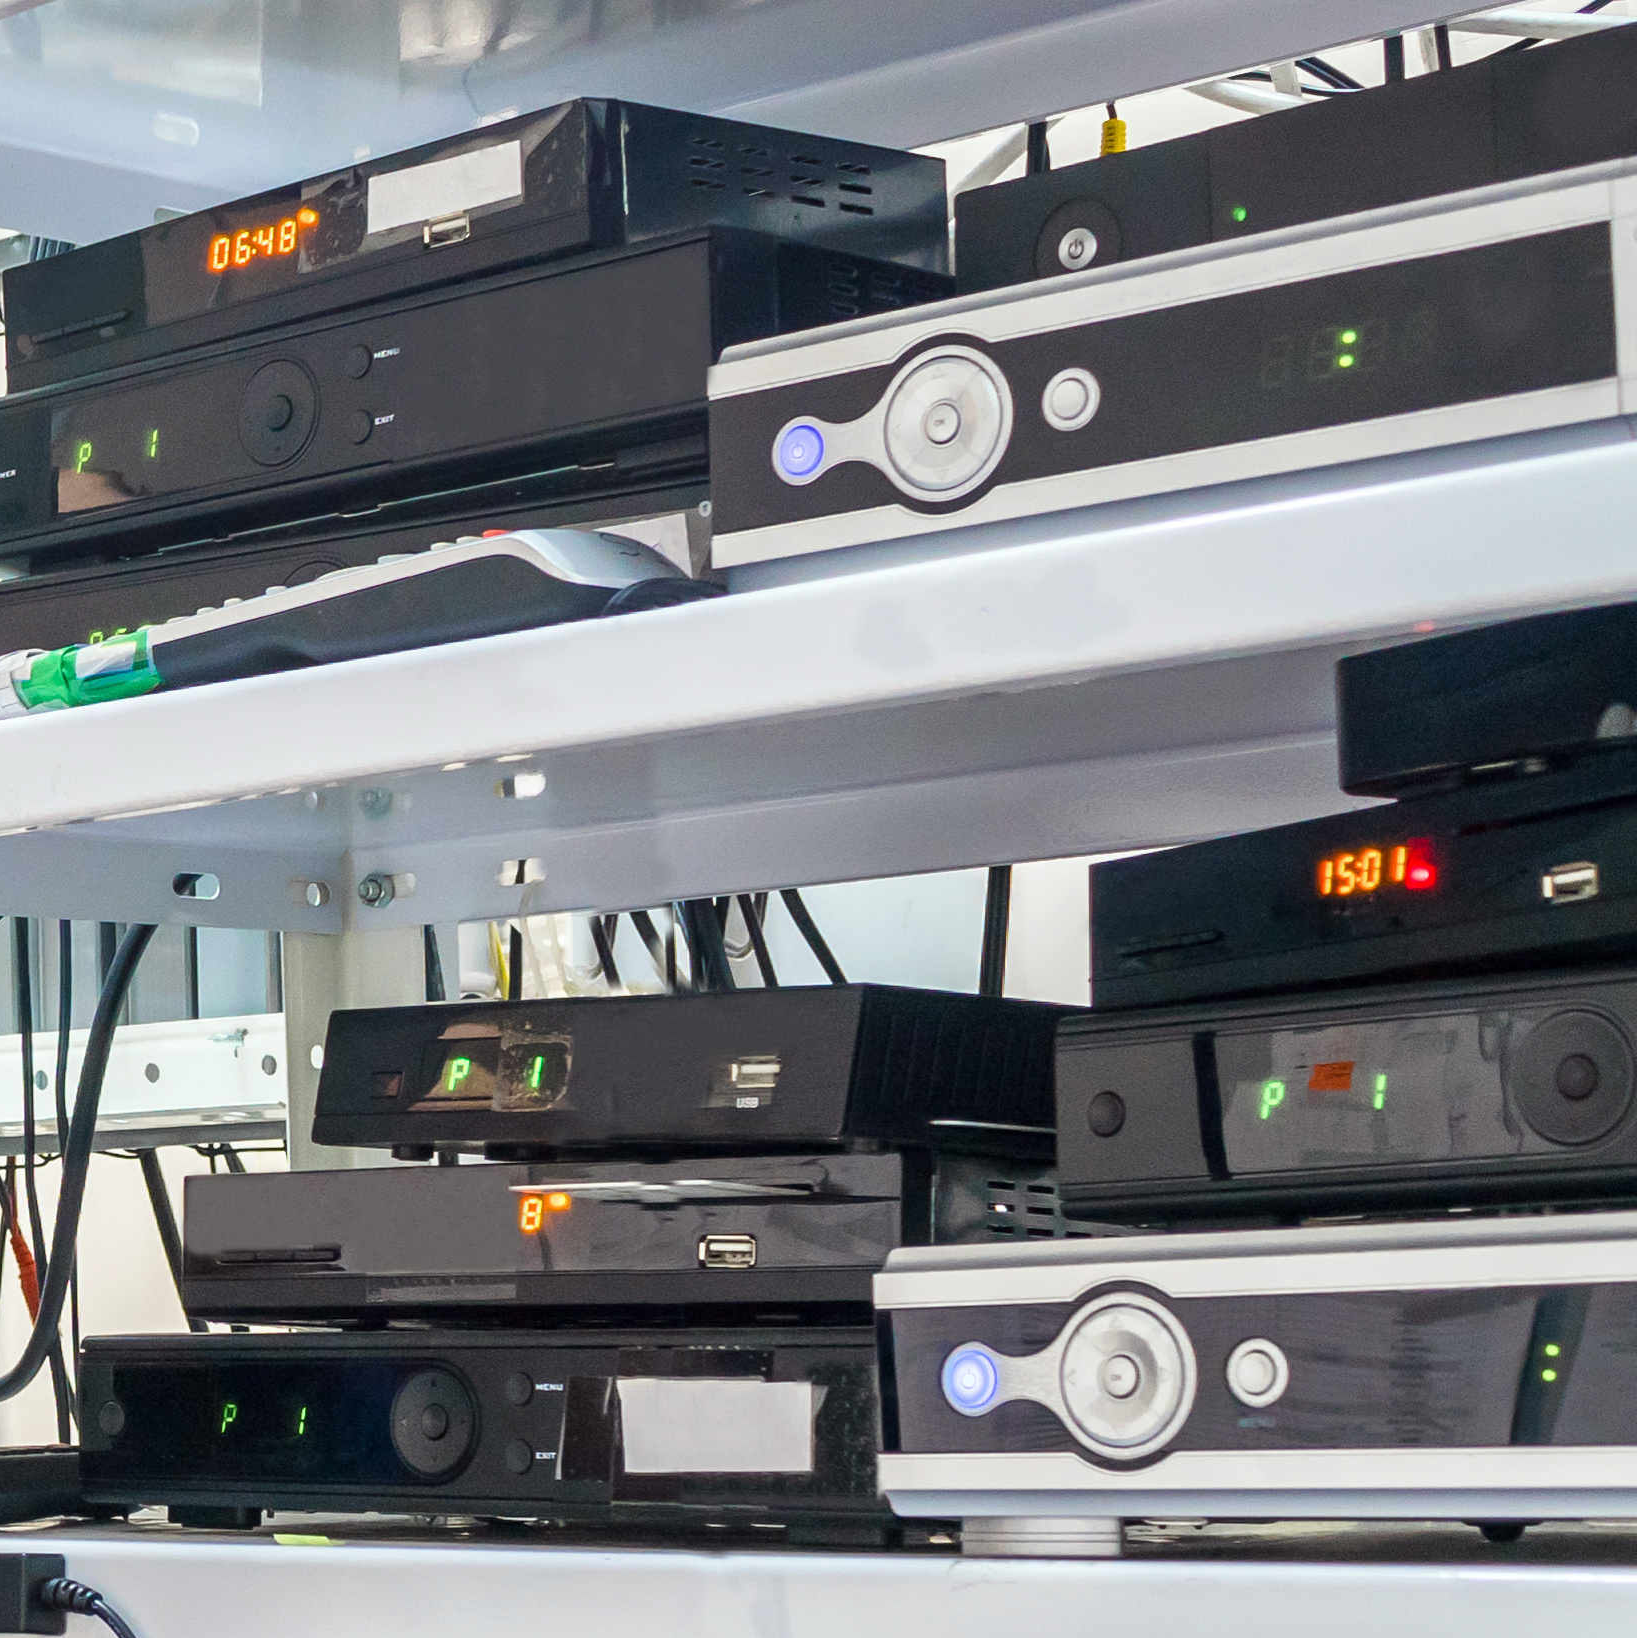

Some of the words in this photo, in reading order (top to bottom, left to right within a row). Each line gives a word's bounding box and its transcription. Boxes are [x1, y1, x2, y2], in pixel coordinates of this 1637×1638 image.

[212, 219, 297, 270] 06:48
[373, 348, 400, 359] MENU
[77, 442, 92, 474] P
[150, 429, 158, 458] 1
[1320, 846, 1406, 895] 15:01
[447, 1057, 471, 1091] P
[529, 1055, 543, 1088] 1
[736, 1097, 759, 1108] USB
[1259, 1081, 1285, 1120] P
[1374, 1073, 1387, 1110] 1
[520, 1198, 543, 1232] 8
[535, 1383, 564, 1392] MENU
[221, 1404, 237, 1434] P
[298, 1407, 307, 1435] 1
[535, 1451, 556, 1460] EXIT
